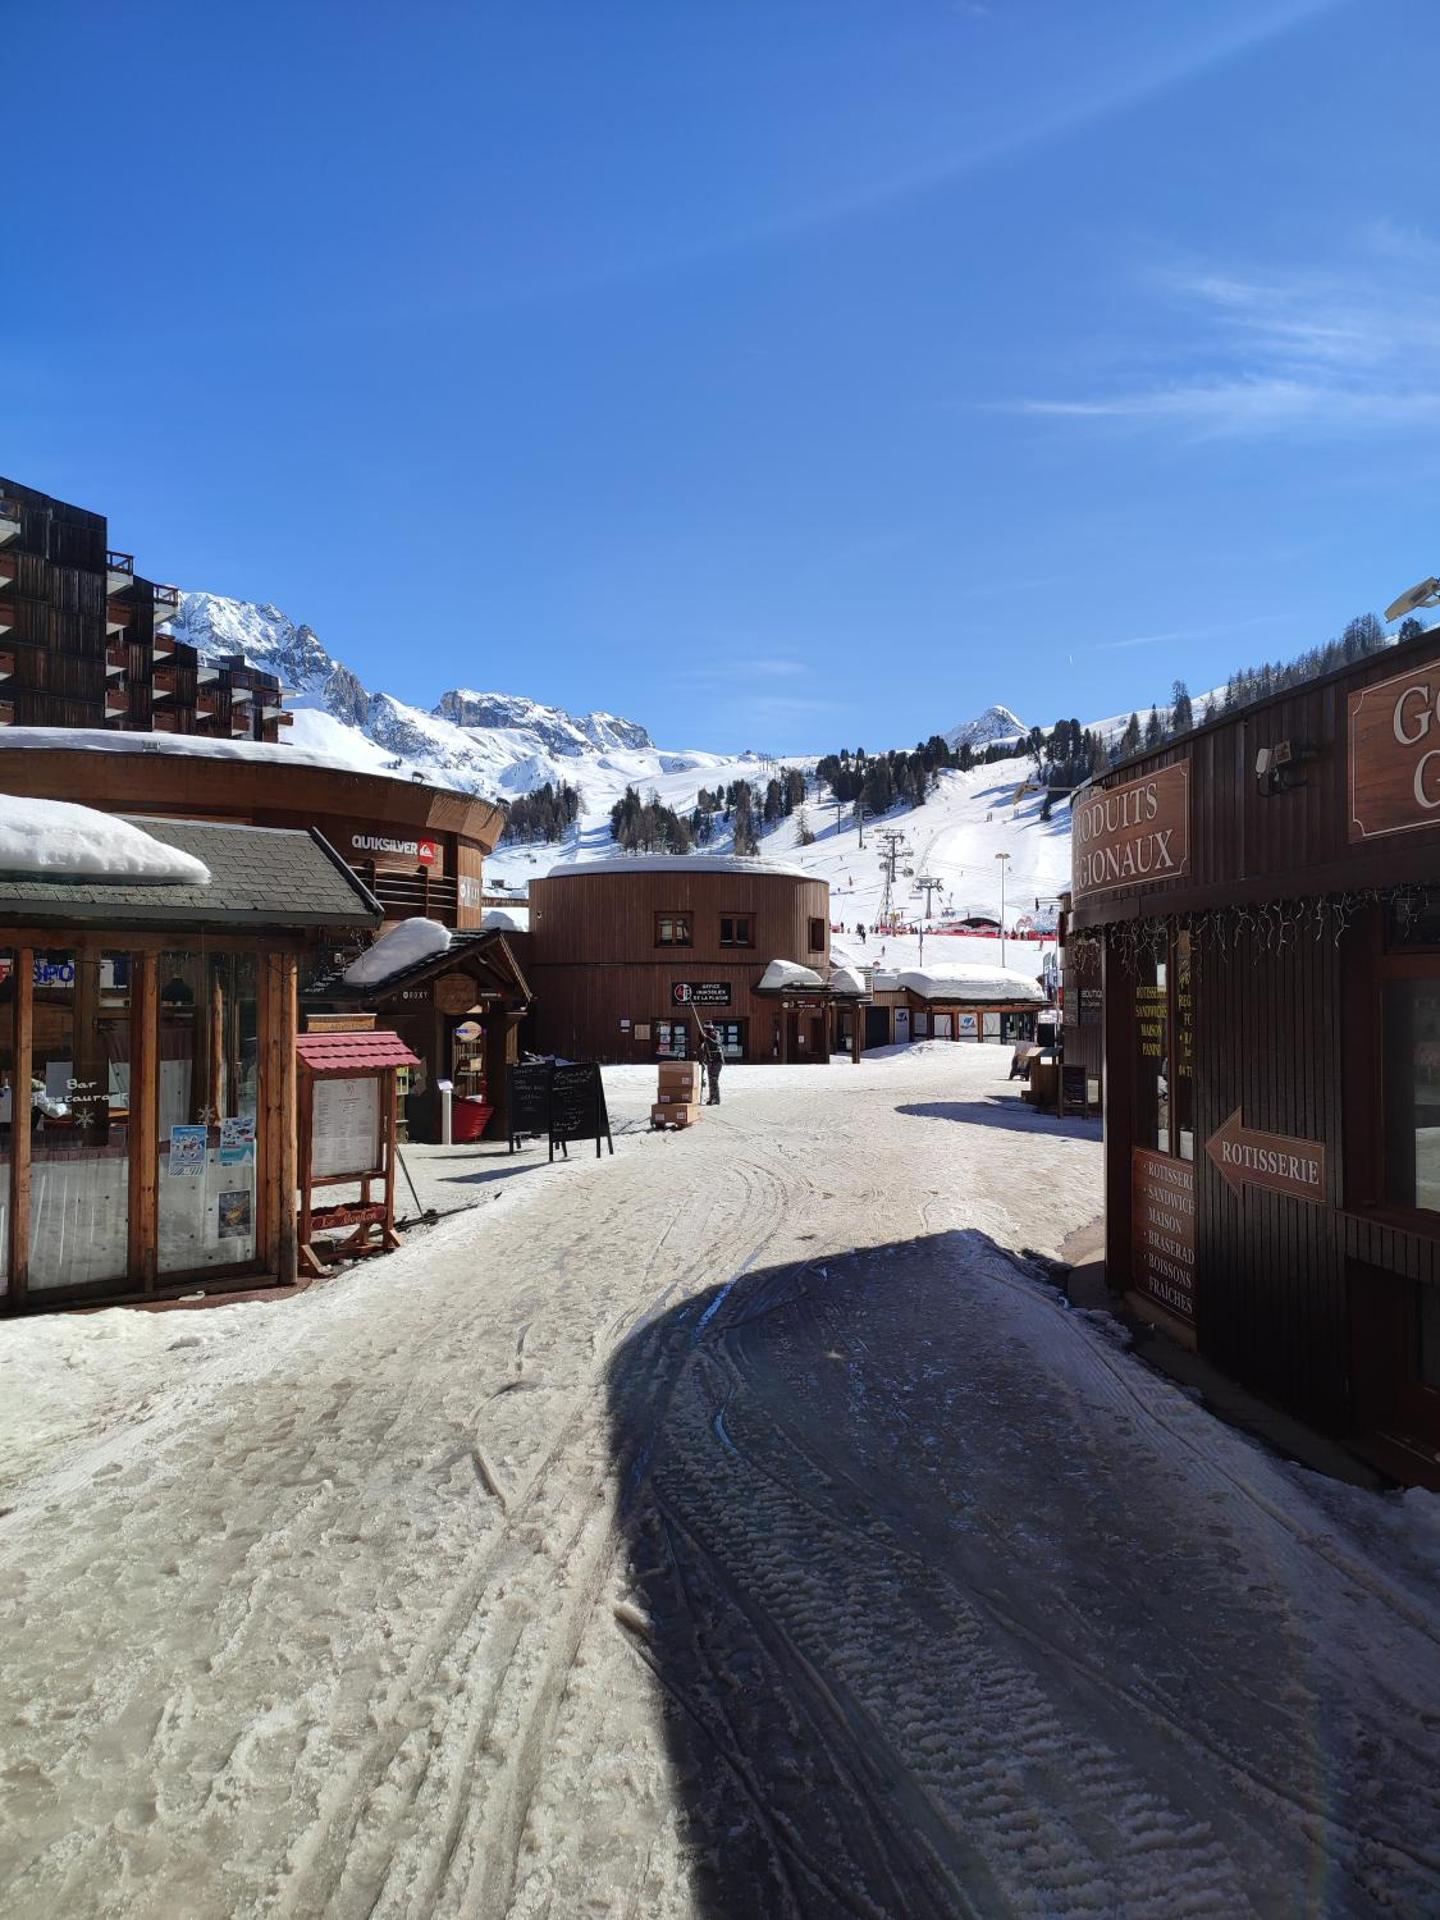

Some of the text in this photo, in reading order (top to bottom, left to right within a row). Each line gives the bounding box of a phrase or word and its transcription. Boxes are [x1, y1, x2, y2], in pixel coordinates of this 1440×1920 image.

[351, 834, 418, 856] QUIKSILVER
[66, 1078, 98, 1090] Bar
[31, 1092, 129, 1104] Restaurat
[1222, 1141, 1319, 1185] ROTISSERIE
[1149, 1207, 1182, 1234] MAISON
[1149, 1253, 1192, 1289] BOISSONS
